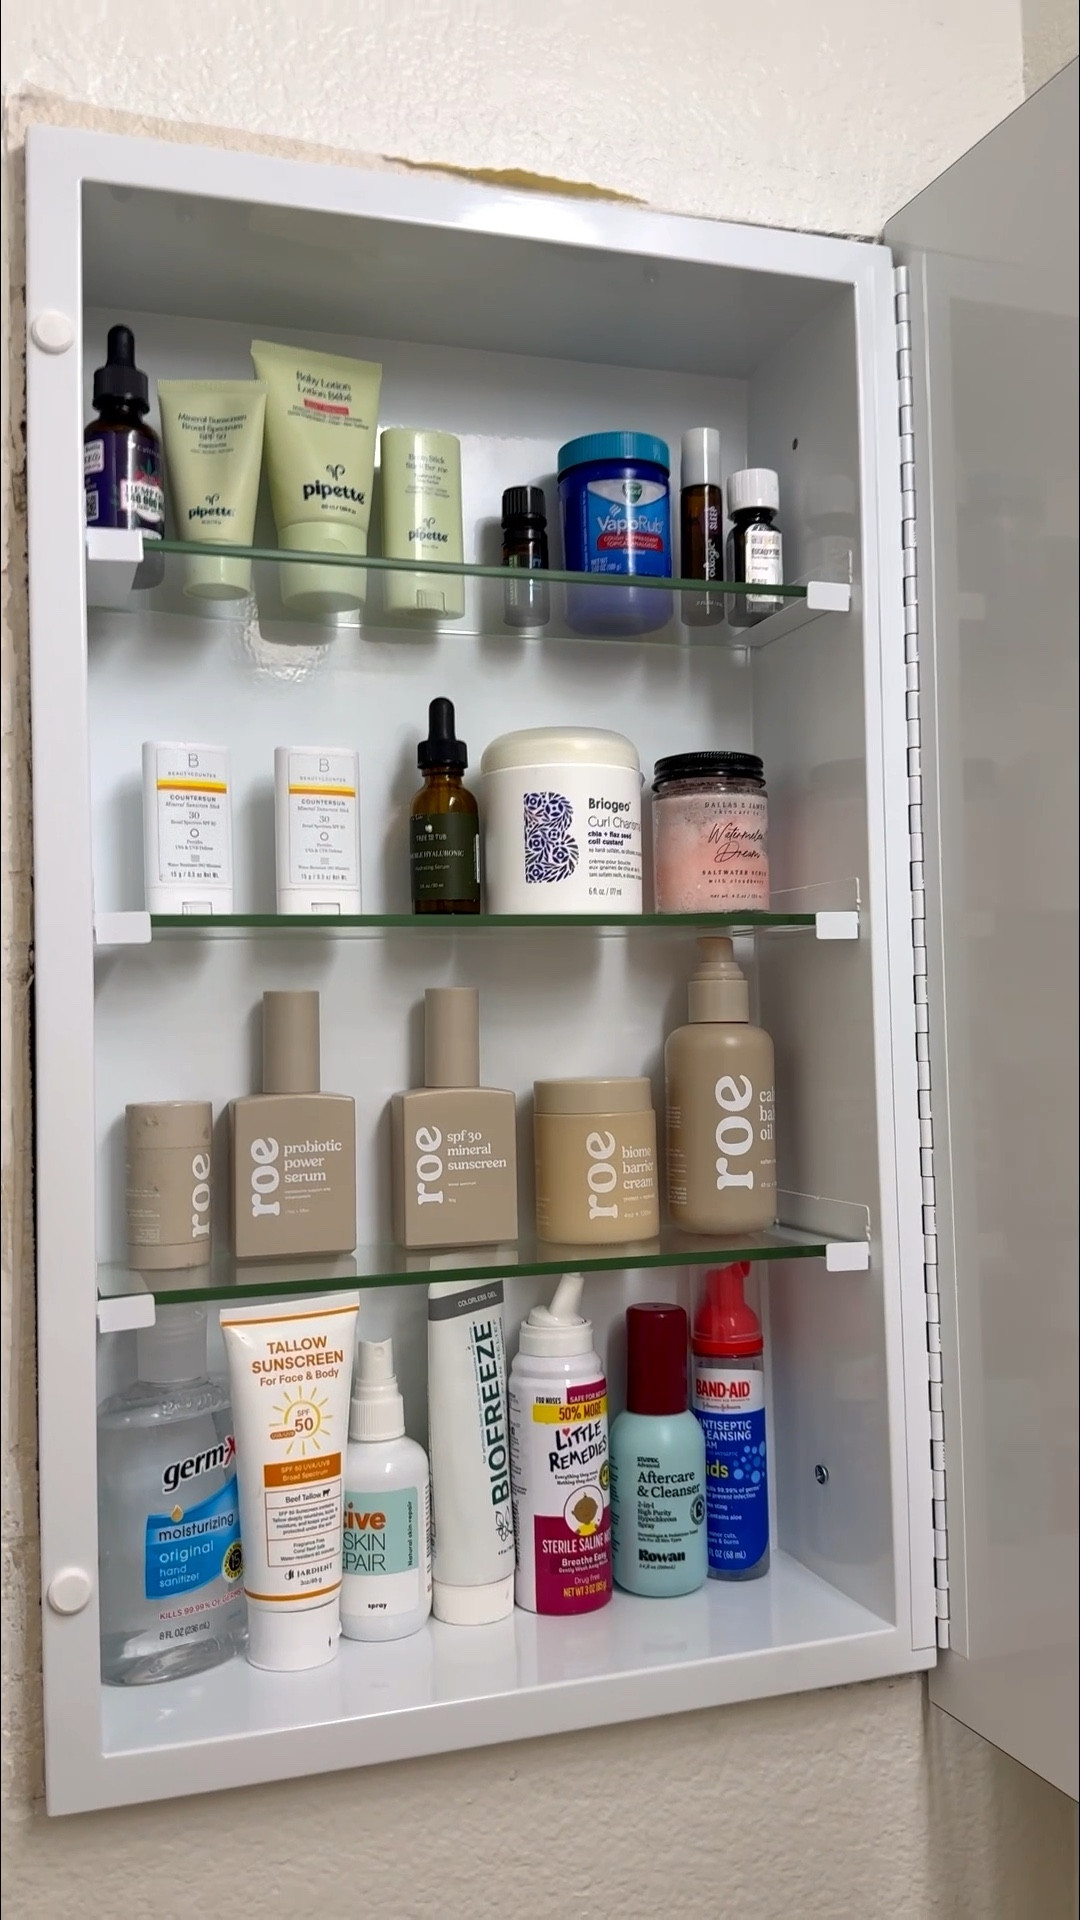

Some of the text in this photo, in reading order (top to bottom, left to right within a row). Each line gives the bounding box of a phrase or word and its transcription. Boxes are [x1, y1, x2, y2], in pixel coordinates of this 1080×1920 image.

[178, 412, 207, 423] Mineral
[303, 480, 365, 505] pipette
[188, 506, 235, 520] pipette
[597, 514, 664, 536] VapoRub
[408, 529, 449, 543] pipette
[170, 794, 216, 802] COUNTERSUN
[588, 797, 631, 813] Briogeo
[704, 801, 738, 809] DALLAS
[188, 811, 200, 819] 30
[319, 815, 330, 824] 30
[588, 815, 611, 827] Curl
[447, 1129, 482, 1144] spf 30
[714, 1074, 754, 1190] roe
[760, 1124, 773, 1140] oil
[283, 1140, 342, 1157] probiotic
[447, 1143, 492, 1156] mineral
[621, 1146, 652, 1159] biome
[284, 1157, 325, 1172] power
[415, 1125, 444, 1206] roe
[447, 1159, 507, 1171] sunscreen
[622, 1160, 654, 1174] barrier
[250, 1137, 280, 1217] roe
[284, 1172, 327, 1183] serum
[585, 1131, 619, 1220] roe
[623, 1177, 654, 1189] cream
[191, 1153, 211, 1238] roe
[457, 1291, 498, 1308] COLORLESS GEL
[267, 1336, 327, 1355] TALLOW
[252, 1350, 344, 1374] SUNSCREEN
[260, 1368, 339, 1387] For Face & Body
[696, 1378, 750, 1398] BAND-AID
[535, 1396, 544, 1404] FOR
[569, 1394, 584, 1403] SAFE
[585, 1392, 595, 1401] FOR
[297, 1409, 310, 1417] SPF
[473, 1320, 511, 1506] BIOFREEZE
[558, 1401, 602, 1421] 50% MORE
[294, 1417, 314, 1432] 50
[699, 1418, 752, 1431] NTISEPTIC
[705, 1430, 752, 1441] EANSING
[706, 1440, 718, 1450] AM
[548, 1434, 608, 1472] REMEDIES
[281, 1466, 292, 1474] SPF
[282, 1469, 329, 1482] Broad Spectrum
[706, 1459, 729, 1479] ids
[638, 1470, 695, 1484] Aftercare
[637, 1483, 700, 1498] & Cleanser
[285, 1492, 322, 1504] Beef Tallow
[653, 1509, 672, 1517] Purity
[158, 1512, 234, 1542] moisturizing
[343, 1532, 386, 1552] SKIN
[542, 1539, 577, 1554] STERILE
[579, 1533, 604, 1552] SALINE
[159, 1540, 215, 1563] original
[638, 1548, 686, 1563] Rowan
[723, 1550, 734, 1560] (68
[561, 1556, 593, 1567] Breathe
[159, 1564, 187, 1577] hand
[159, 1572, 200, 1588] sanitizer
[574, 1577, 590, 1586] Drug
[563, 1587, 575, 1598] NET
[575, 1586, 584, 1596] WT
[585, 1585, 589, 1595] 3
[160, 1609, 182, 1620] KILLS
[184, 1603, 210, 1613] 99.99%
[367, 1602, 388, 1610] spray
[159, 1632, 164, 1640] 8
[174, 1627, 184, 1637] OZ
